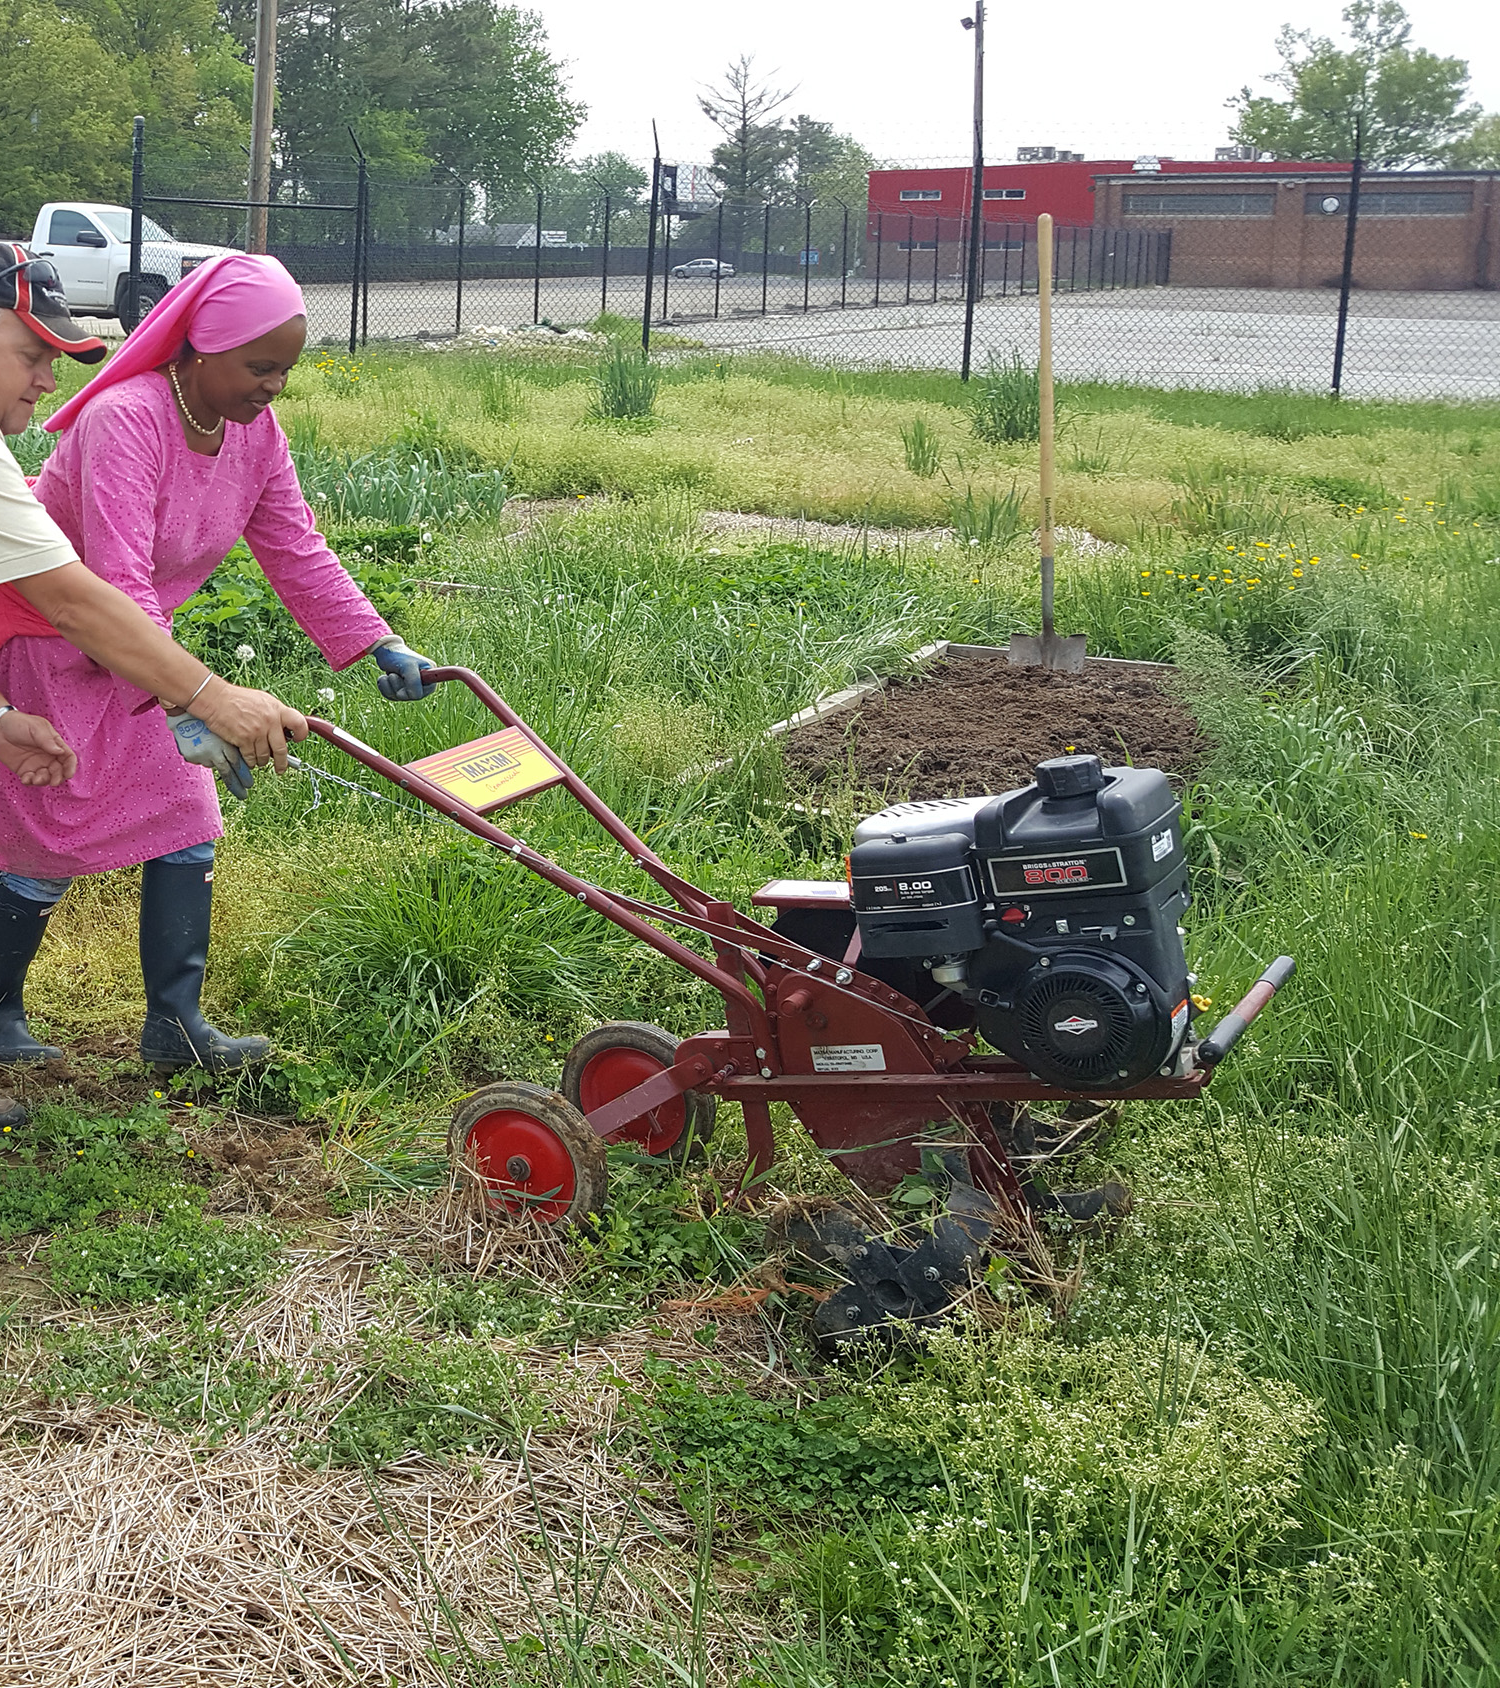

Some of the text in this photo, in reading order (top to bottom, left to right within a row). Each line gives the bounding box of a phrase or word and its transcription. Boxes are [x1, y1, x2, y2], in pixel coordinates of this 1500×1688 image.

[461, 753, 513, 778] MAXIM
[1022, 862, 1048, 870] BRIGGS
[1051, 860, 1085, 868] STRATTON
[1023, 865, 1088, 885] 800
[898, 881, 932, 891] 8.00
